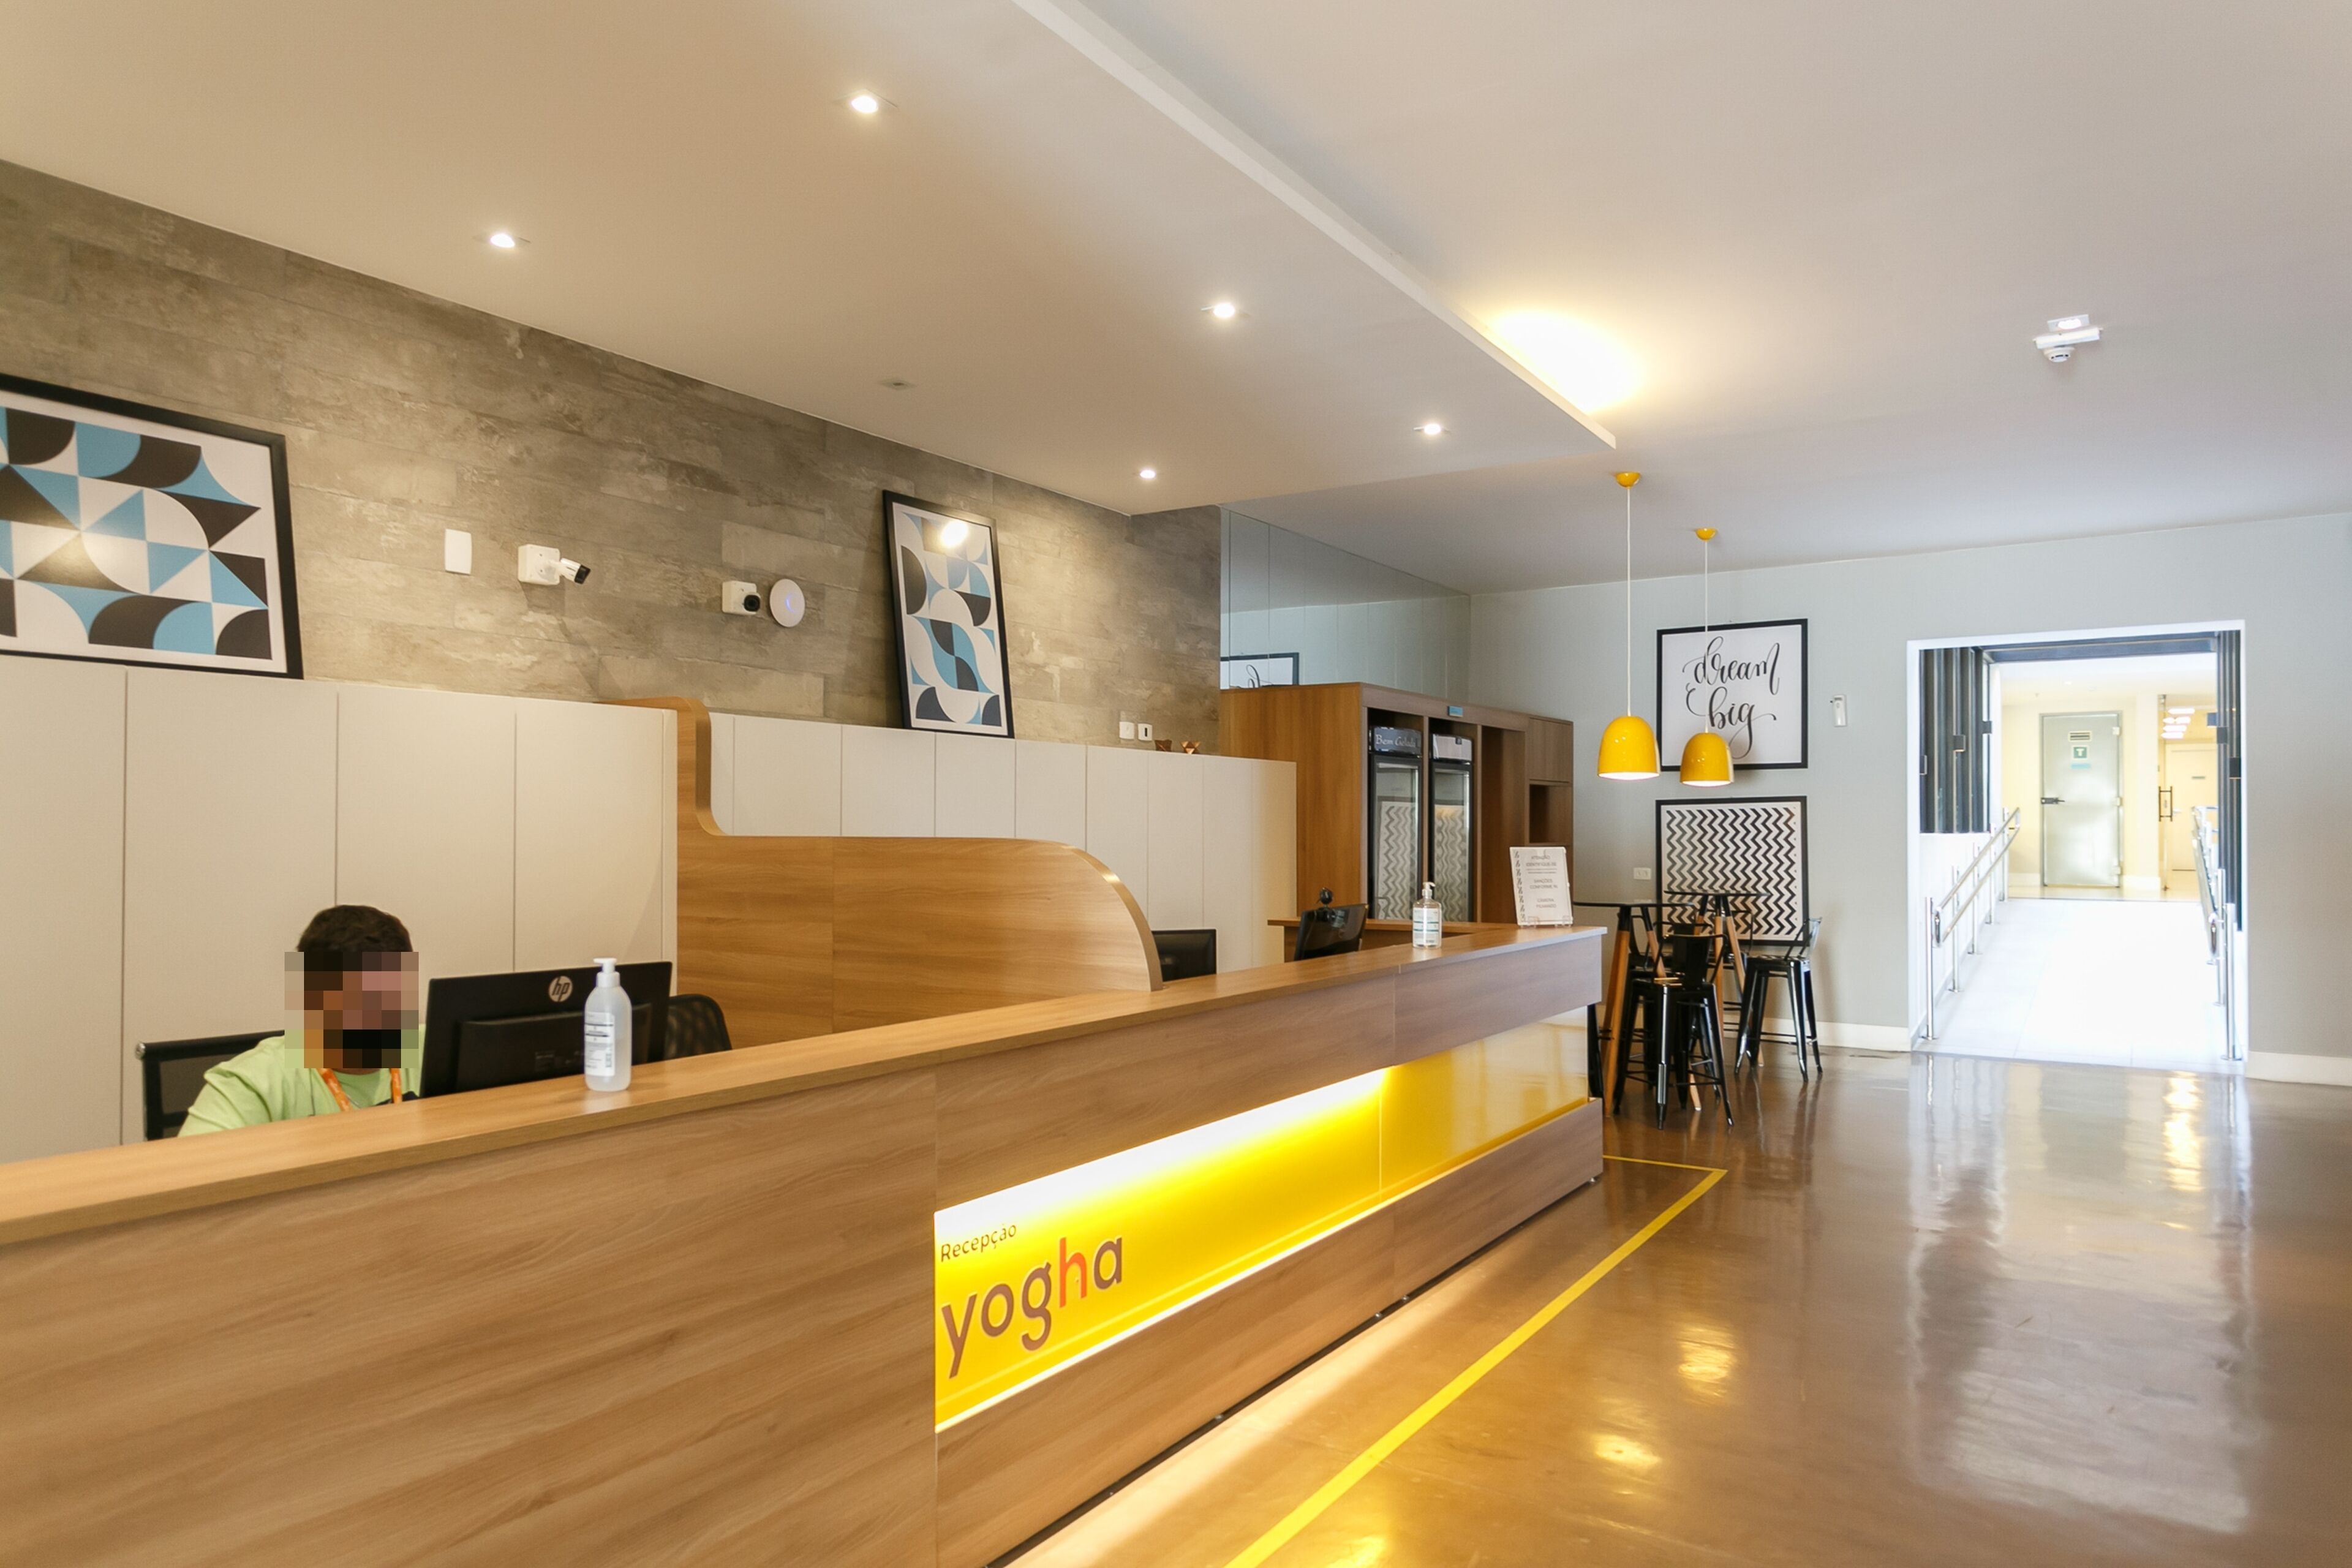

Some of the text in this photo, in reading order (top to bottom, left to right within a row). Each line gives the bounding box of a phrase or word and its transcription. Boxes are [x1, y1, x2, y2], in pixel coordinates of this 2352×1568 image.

[1683, 636, 1780, 695] dream
[1375, 734, 1393, 745] Bem
[1686, 684, 1776, 759] big
[551, 975, 571, 1002] hp
[941, 1224, 1017, 1262] Recepção
[941, 1237, 1123, 1379] yogha
